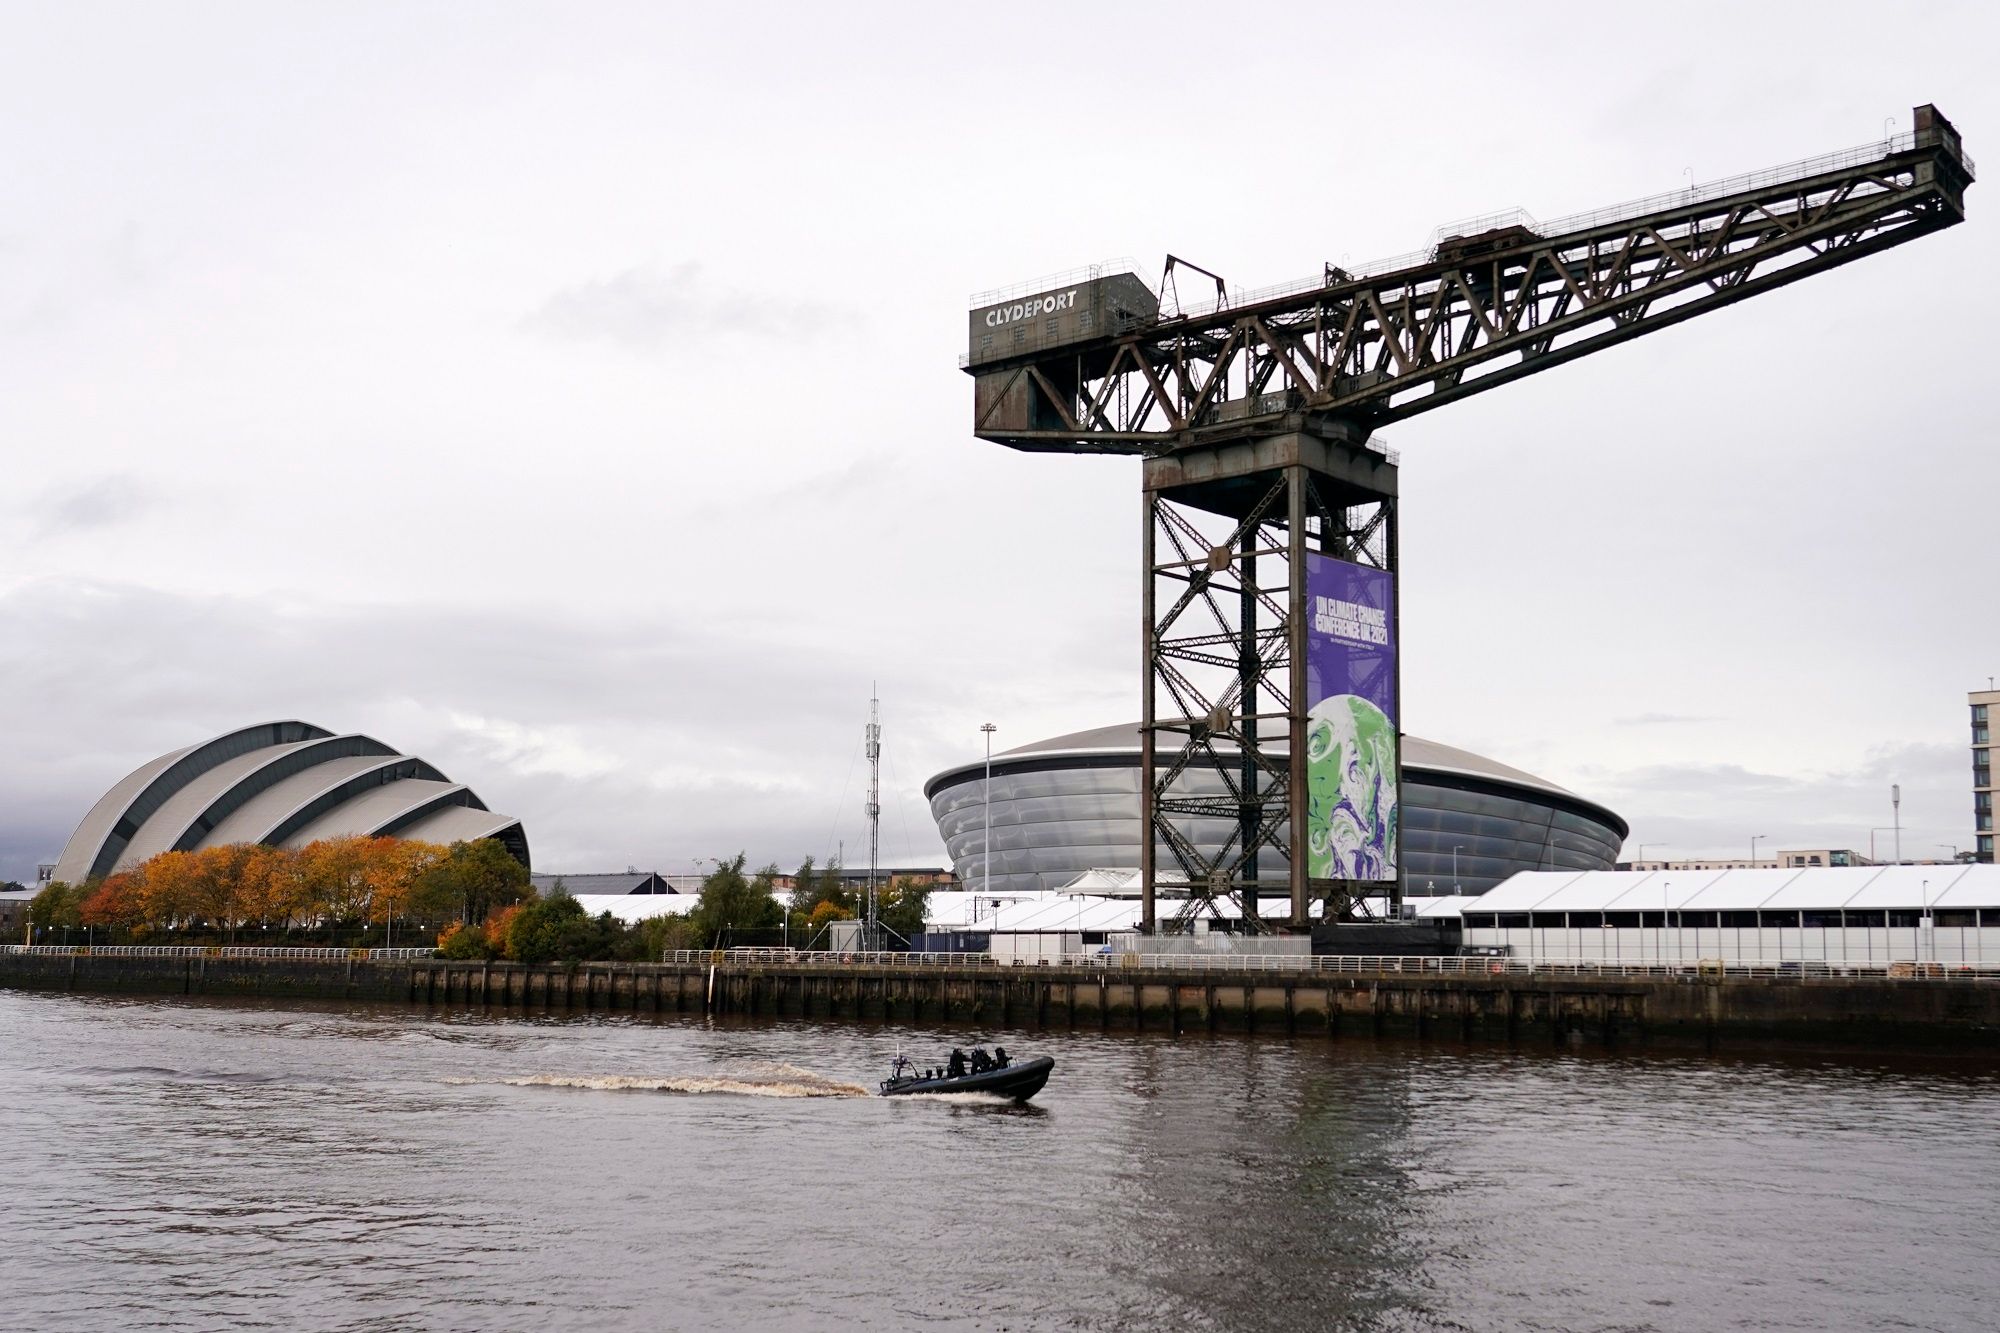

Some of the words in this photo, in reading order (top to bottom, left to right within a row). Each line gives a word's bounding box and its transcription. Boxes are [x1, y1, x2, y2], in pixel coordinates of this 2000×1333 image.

[985, 290, 1077, 327] CLYDEPORT
[1316, 595, 1328, 615] UN
[1327, 598, 1358, 622] CLIMATE
[1358, 605, 1386, 627] CHANGE
[1315, 613, 1361, 640] CONFERENCE
[1360, 623, 1371, 642] UK
[1371, 627, 1388, 646] 2021
